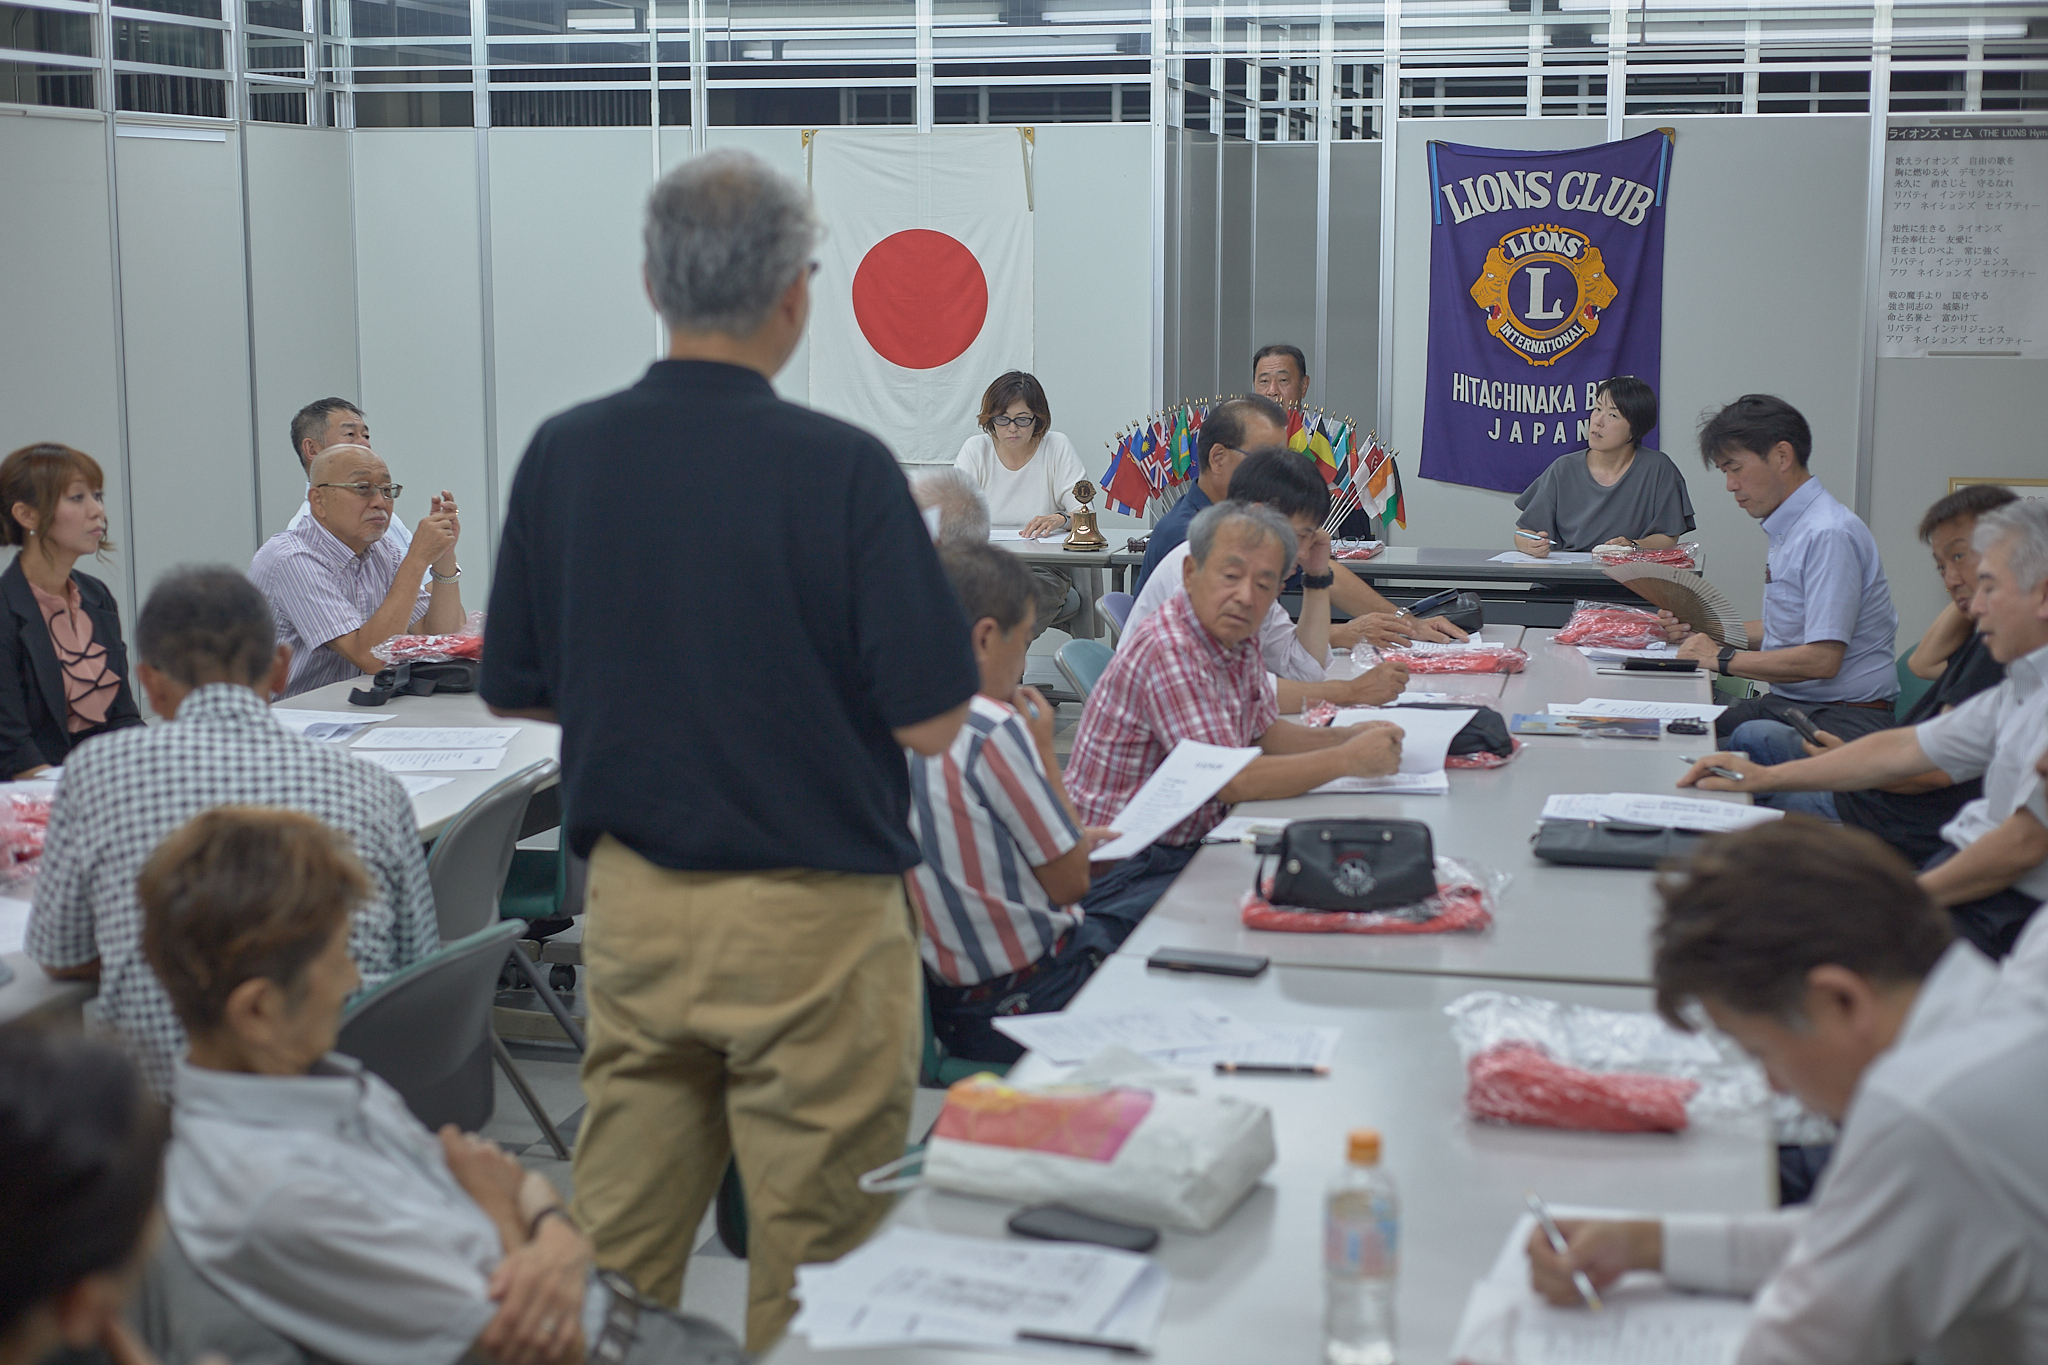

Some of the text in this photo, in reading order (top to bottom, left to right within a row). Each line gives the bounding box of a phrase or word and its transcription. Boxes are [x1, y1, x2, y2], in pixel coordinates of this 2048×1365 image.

[1889, 128, 1973, 138] ライオンズ・ヒム
[2003, 129, 2026, 137] LIONS
[2030, 129, 2048, 138] Hym
[1896, 157, 2015, 165] 歌えライオンズ 自由の歌を
[1959, 168, 2014, 176] デモクラシー
[1894, 179, 2013, 188] 永久に 消さじと 守るなれ
[1441, 170, 1655, 226] LIONS CLUB
[1893, 202, 2040, 210] アワ ネイションズ セイフティー
[1892, 224, 2002, 233] 知性に生きる ライオンズ
[1506, 231, 1583, 258] LIONS
[1946, 236, 1973, 244] 友愛に
[1891, 247, 1999, 255] 手をさしのべよ 常に強く
[1936, 258, 2009, 266] インテリジェンス
[1890, 269, 2036, 277] アワ ネイションズ セイフティー
[1524, 267, 1565, 320] L
[1952, 292, 1989, 300] 国を守る
[1888, 302, 1933, 311] 強き同志の
[1932, 324, 2004, 333] インテリジェンス
[1499, 321, 1586, 354] INTERNATIONAL
[1914, 336, 1968, 344] ネイションズ
[1977, 337, 2032, 345] セイフティー
[1452, 372, 1577, 415] HITACHINAKA
[1487, 418, 1591, 445] JAPAN
